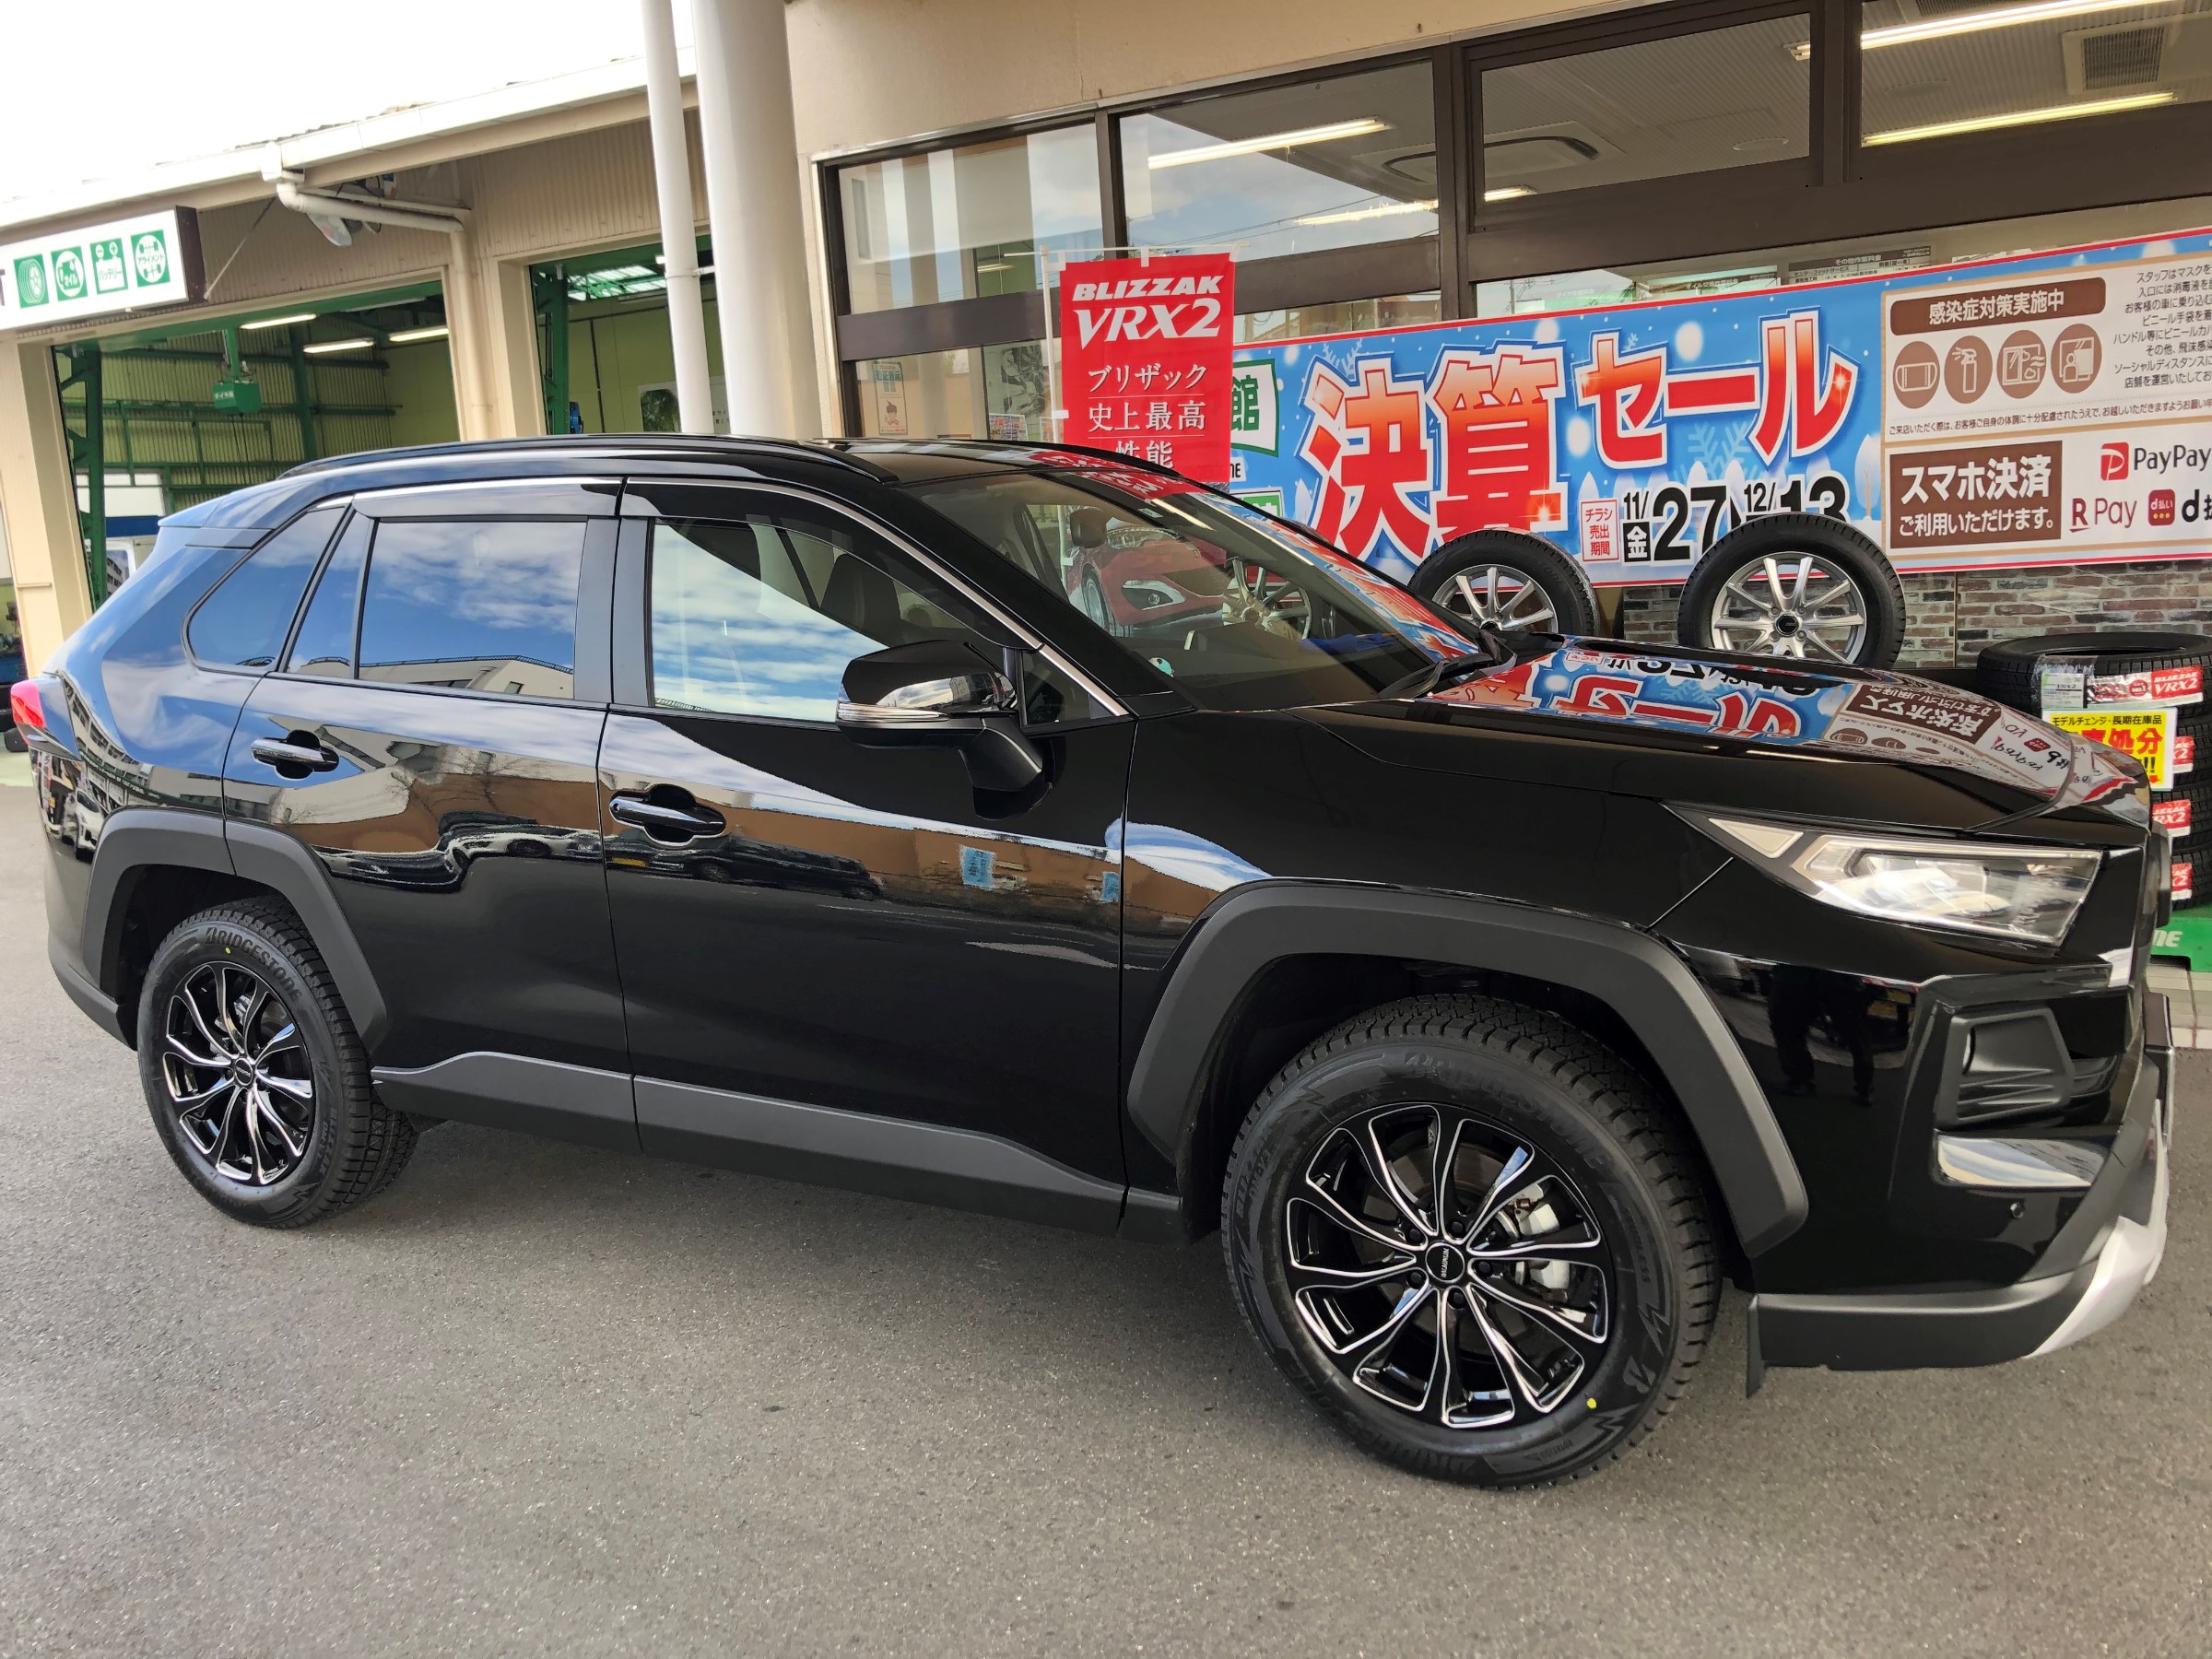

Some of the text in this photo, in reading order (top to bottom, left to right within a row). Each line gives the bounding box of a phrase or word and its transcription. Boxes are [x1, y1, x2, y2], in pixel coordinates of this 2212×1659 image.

[64, 274, 78, 287] オイル
[99, 266, 123, 281] バッテリー
[1072, 276, 1225, 301] BLIZZAK
[1929, 288, 2065, 325] 感染症対策実施中
[1073, 298, 1222, 350] VRX2
[1088, 362, 1207, 393] ブリザック
[1088, 400, 1206, 433] 史上最高
[2134, 444, 2212, 475] PayPay
[1900, 453, 2053, 504] スマホ決済
[1585, 507, 1613, 523] チラシ
[1900, 506, 2054, 537] ご利用いただけます。
[2095, 498, 2137, 528] Pay
[1590, 524, 1610, 539] 売出
[1627, 524, 1649, 559] 金
[1590, 540, 1610, 557] 期間
[2154, 677, 2198, 695] VRX2
